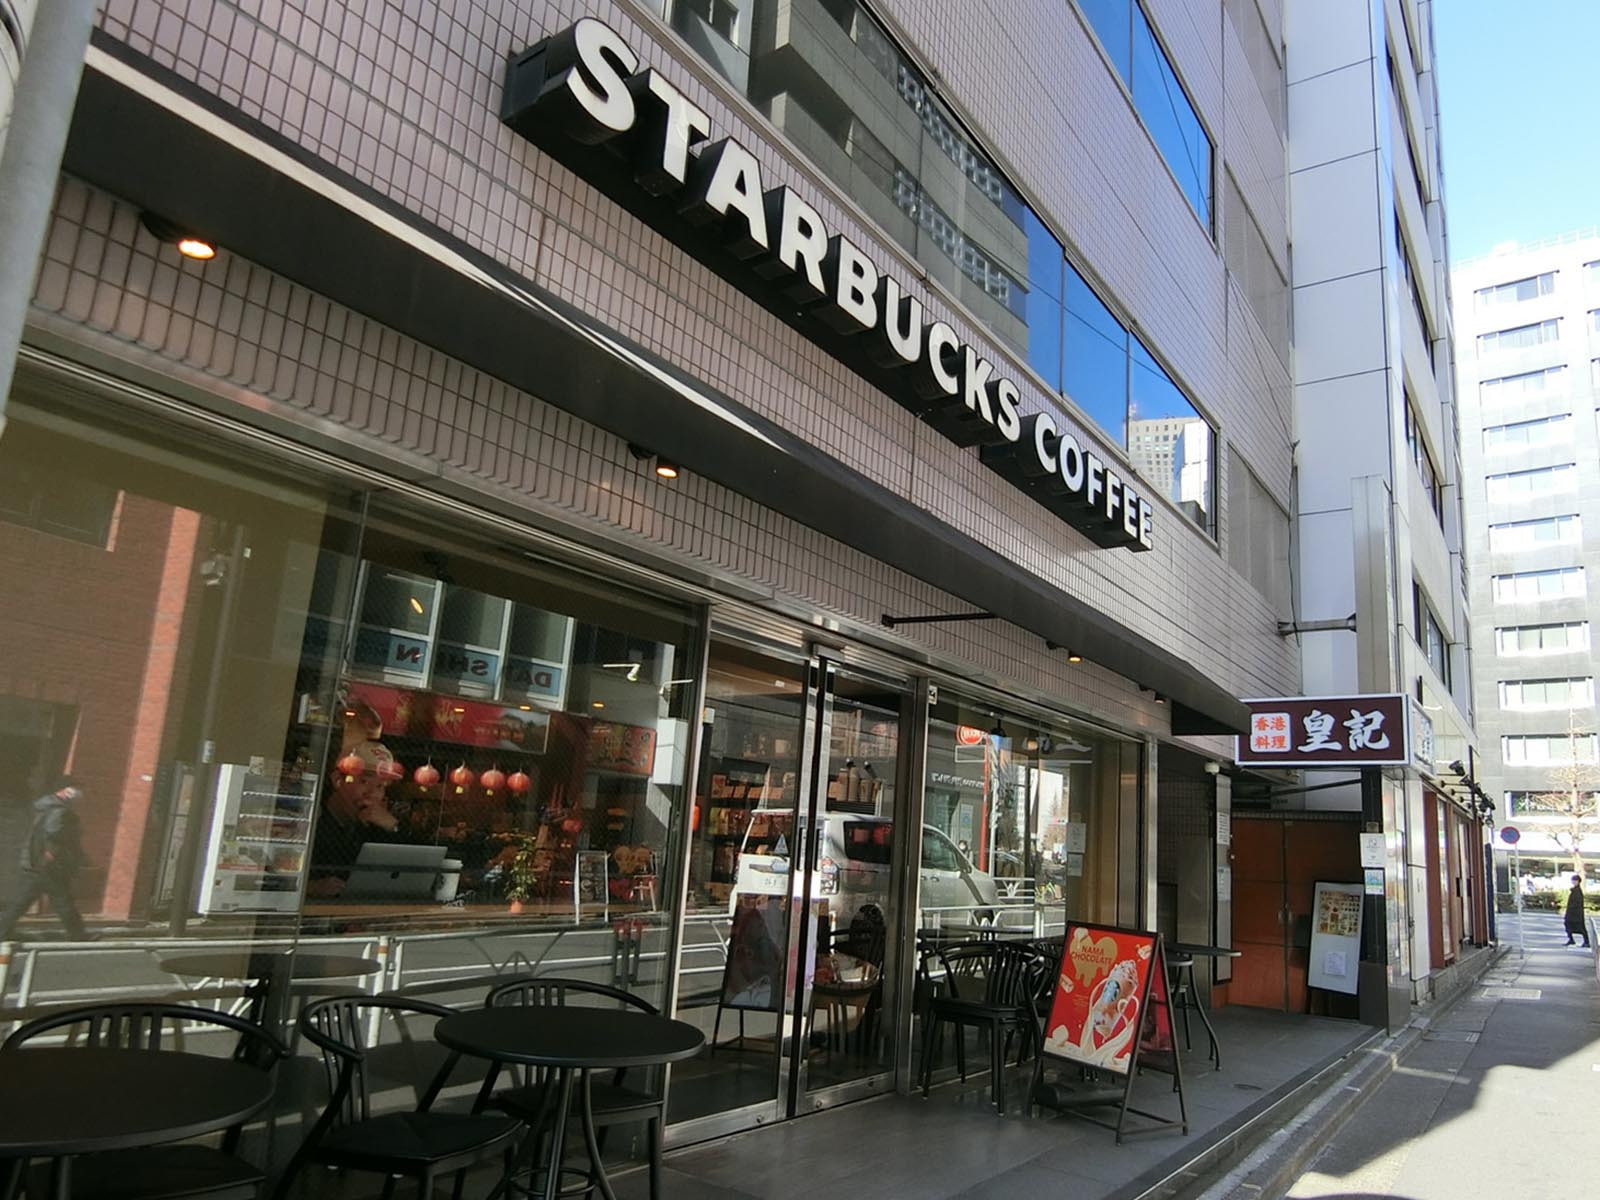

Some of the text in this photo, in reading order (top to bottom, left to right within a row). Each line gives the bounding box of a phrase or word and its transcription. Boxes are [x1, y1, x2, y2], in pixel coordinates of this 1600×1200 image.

[566, 17, 1153, 550] STARBUCKS COFFEE
[1254, 715, 1287, 731] 香港
[1298, 709, 1390, 752] 皇記
[1254, 735, 1288, 750] 料理
[1071, 951, 1113, 965] CHOCOLATE
[1081, 945, 1105, 957] NAMA
